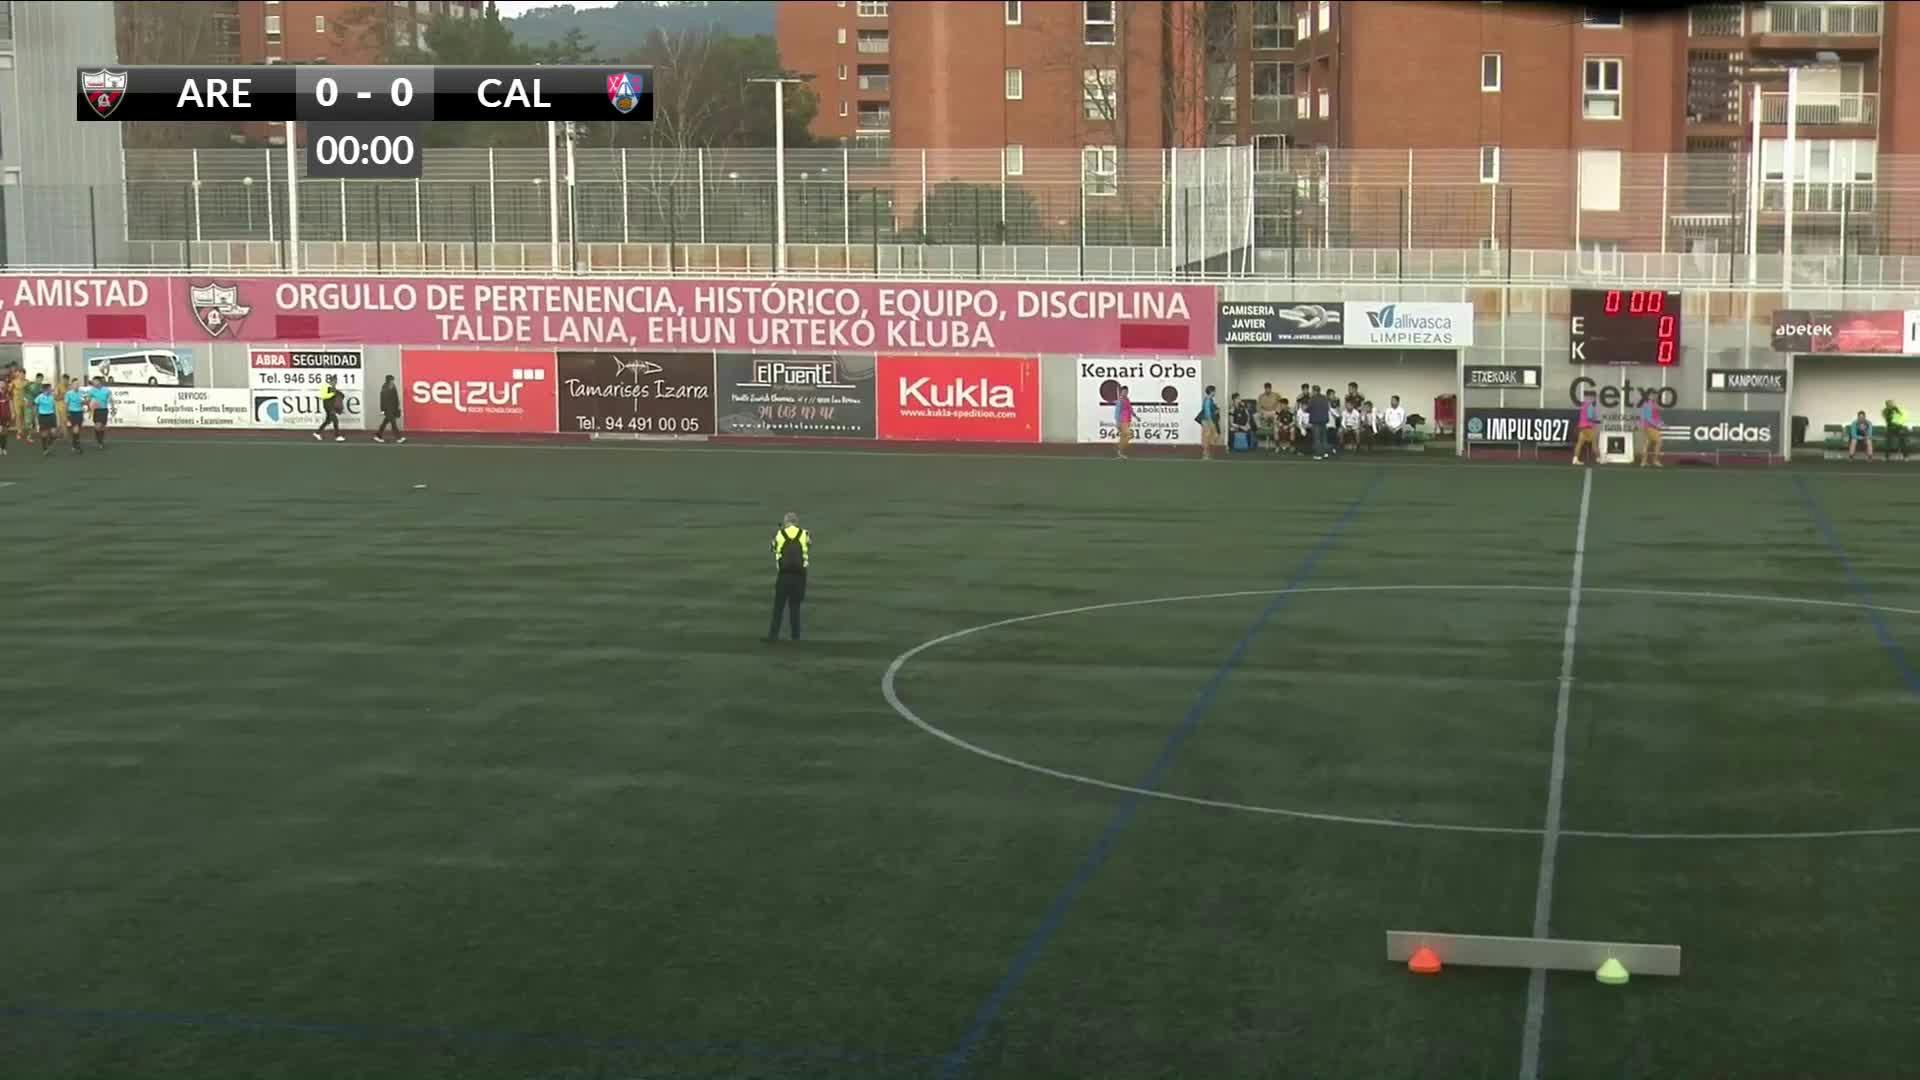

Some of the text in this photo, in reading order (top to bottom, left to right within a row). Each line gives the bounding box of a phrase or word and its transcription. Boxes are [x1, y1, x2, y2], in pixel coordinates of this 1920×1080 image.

[14, 279, 149, 307] AMISTAD
[276, 281, 1190, 322] ORGULLO DE PERTENENCIA, HISTÓRICO, EQUIPO, DISCIPLINA
[1605, 290, 1620, 313] 0
[1222, 305, 1275, 315] CAMISERIA
[435, 314, 996, 348] TALDE LANA, EHUN URTEKO KLUBA
[1231, 318, 1266, 329] JAVIER
[1572, 316, 1585, 335] E
[1659, 316, 1674, 338] 0
[1776, 323, 1833, 336] abetek
[1225, 331, 1272, 342] JAUREGUI
[1370, 333, 1453, 344] LIMPIEZAS
[1572, 341, 1586, 360] K
[1658, 341, 1673, 363] 0
[255, 354, 358, 367] ABRA SEGURIDAD
[260, 373, 281, 384] Tel.
[285, 373, 305, 384] 946
[308, 373, 322, 384] 56
[344, 374, 356, 384] 11
[1081, 363, 1197, 378] Kenari Orbe
[412, 380, 524, 413] selzur
[564, 378, 649, 398] Tamarises
[654, 379, 709, 399] Izarra
[899, 376, 1015, 408] Kukla
[1569, 376, 1678, 408] Getxo
[900, 408, 1017, 419] www.kukla-spedition.com
[576, 416, 699, 432] Tel. 94 491 00 05
[1486, 418, 1570, 441] IMPULSO27
[1694, 422, 1771, 442] adidas
[1144, 428, 1161, 440] 64
[1164, 428, 1179, 440] 75
